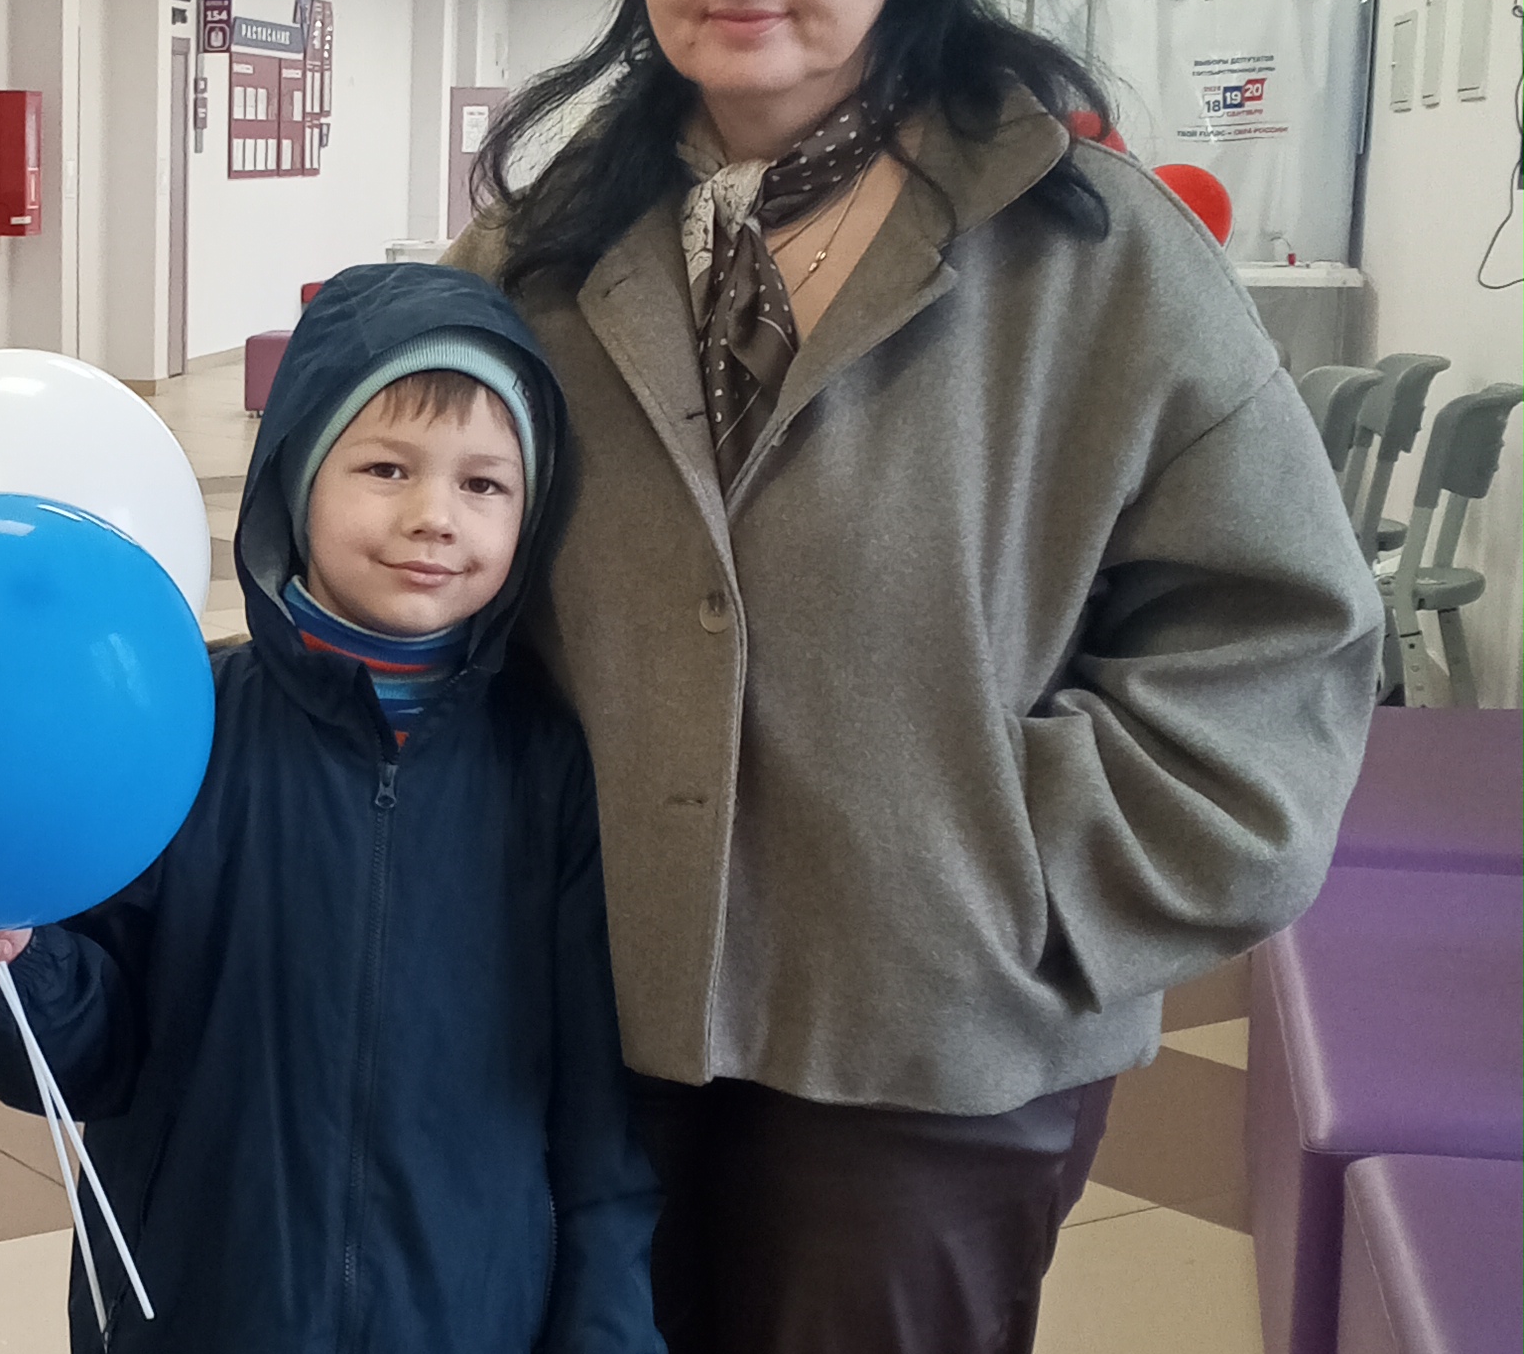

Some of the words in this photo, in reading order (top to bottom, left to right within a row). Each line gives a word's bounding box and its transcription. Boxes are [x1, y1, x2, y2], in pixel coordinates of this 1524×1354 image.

[206, 10, 228, 21] 154
[241, 23, 291, 45] РАСПИСАНИЕ
[1205, 100, 1221, 113] 18
[1224, 90, 1242, 105] 19
[1244, 83, 1262, 98] 20
